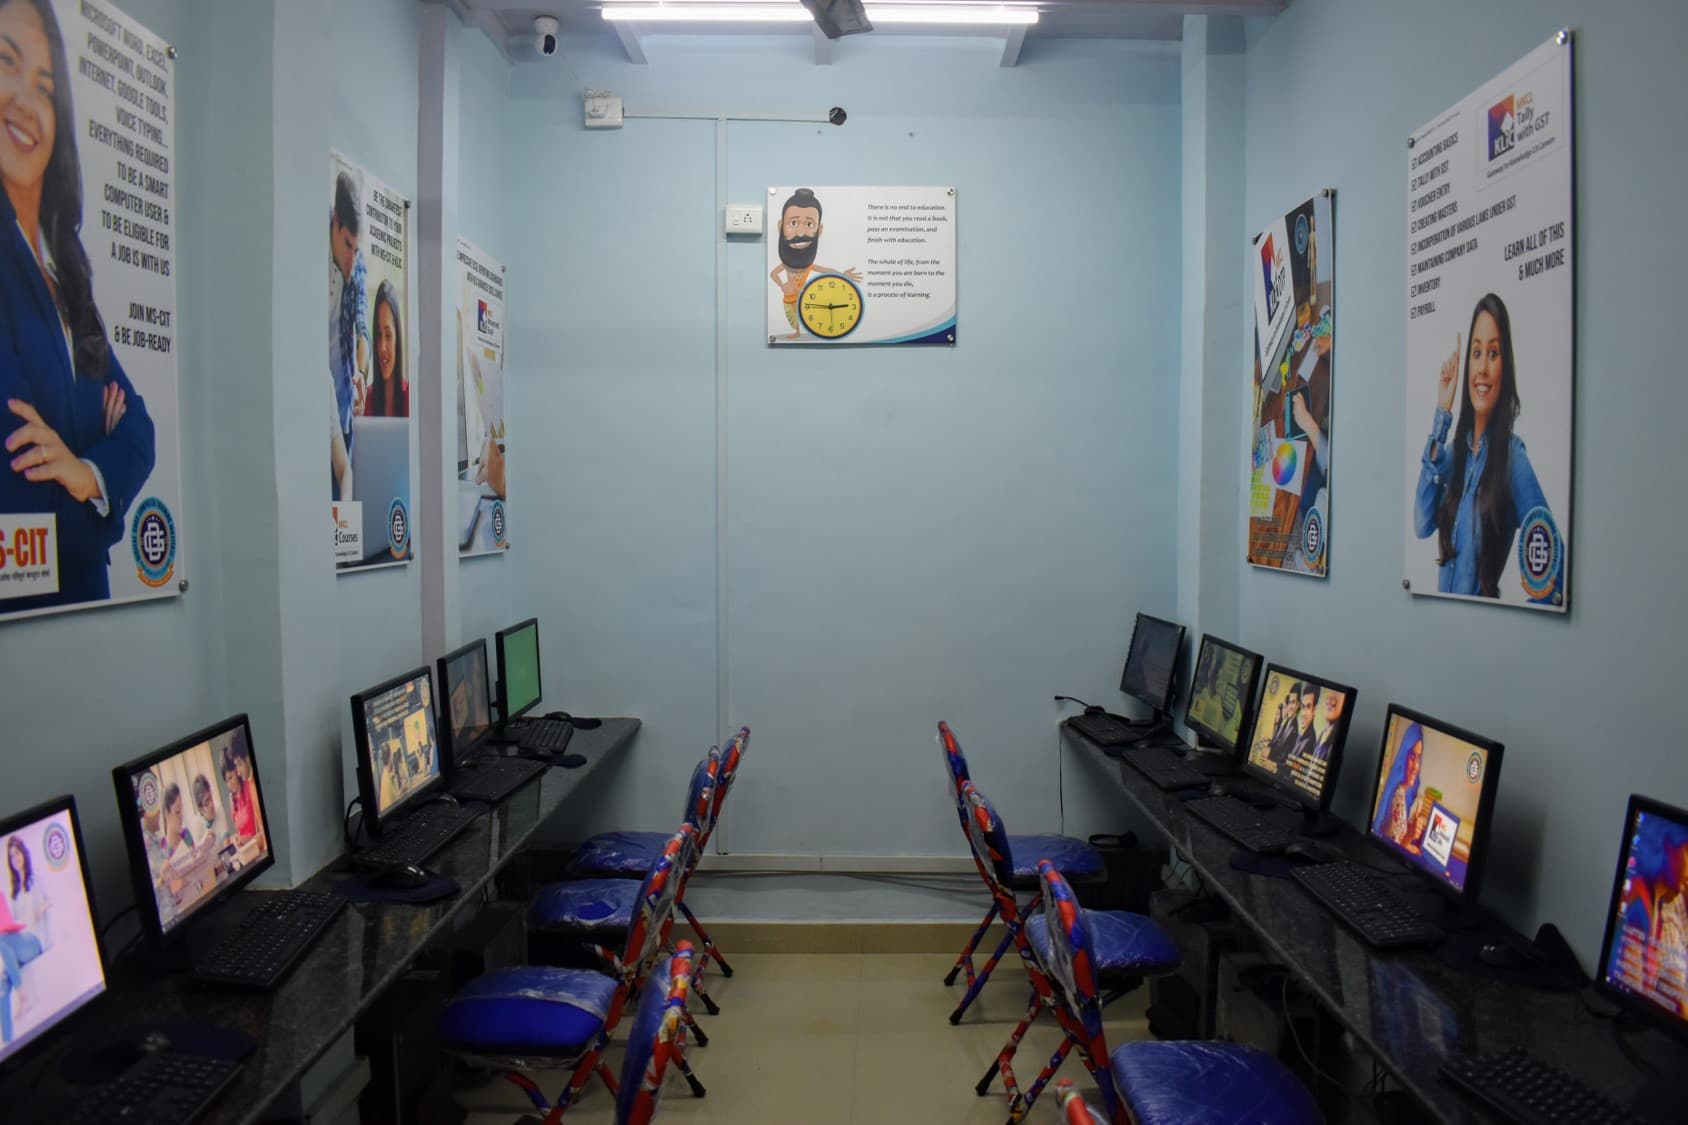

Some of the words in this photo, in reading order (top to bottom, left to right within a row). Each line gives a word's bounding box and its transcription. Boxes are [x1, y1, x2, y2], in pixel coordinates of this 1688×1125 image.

[116, 105, 136, 133] VOICE
[1517, 106, 1535, 127] Tally
[1517, 124, 1534, 141] with
[1535, 111, 1550, 131] GST
[89, 119, 134, 158] EVERYTHING
[135, 143, 168, 174] REQUIRED
[1417, 141, 1442, 168] ACCOUNTING
[1442, 132, 1459, 154] BASICS
[117, 161, 126, 180] TO
[127, 166, 137, 186] BE
[138, 172, 144, 188] A
[145, 176, 168, 200] SMART
[1417, 171, 1429, 187] TALLY
[1430, 166, 1440, 181] WITH
[1440, 161, 1449, 176] GST
[104, 183, 144, 216] COMPUTER
[144, 199, 163, 222] USER
[164, 209, 169, 225] &
[1417, 189, 1436, 210] VOUCHER
[1437, 182, 1451, 200] ENTRY
[101, 210, 111, 229] TO
[113, 215, 123, 234] BE
[124, 219, 155, 246] ELIGIBLE
[156, 233, 169, 251] FOR
[1417, 210, 1437, 231] CREATING
[1437, 201, 1458, 222] MASTERS
[1417, 227, 1450, 252] INCORPORATION
[1450, 225, 1457, 237] OF
[1457, 215, 1475, 234] VARIOUS
[1475, 210, 1489, 227] LAWS
[1489, 202, 1506, 222] UNDER
[1506, 195, 1517, 211] GST
[1417, 254, 1445, 274] MAINTAINING
[1445, 244, 1466, 264] COMPANY
[1466, 238, 1478, 254] DATA
[1504, 240, 1525, 262] LEARN
[1526, 234, 1538, 252] ALL
[1539, 228, 1547, 247] OF
[1549, 222, 1564, 242] THIS
[111, 242, 117, 261] A
[118, 245, 131, 264] JOB
[132, 250, 140, 267] IS
[141, 252, 159, 274] WITH
[160, 260, 170, 277] US
[1519, 264, 1524, 281] &
[1525, 255, 1544, 280] MUCH
[1545, 248, 1565, 269] MORE
[848, 293, 853, 301] 2
[900, 291, 906, 299] of
[1417, 277, 1441, 296] INVENTORY
[129, 301, 144, 322] JOIN
[145, 306, 171, 329] MS-CIT
[808, 314, 814, 322] 8
[1417, 300, 1436, 318] PAYROLL
[114, 325, 120, 343] &
[121, 327, 131, 345] BE
[132, 331, 171, 353] JOB-READY
[828, 325, 834, 333] 6
